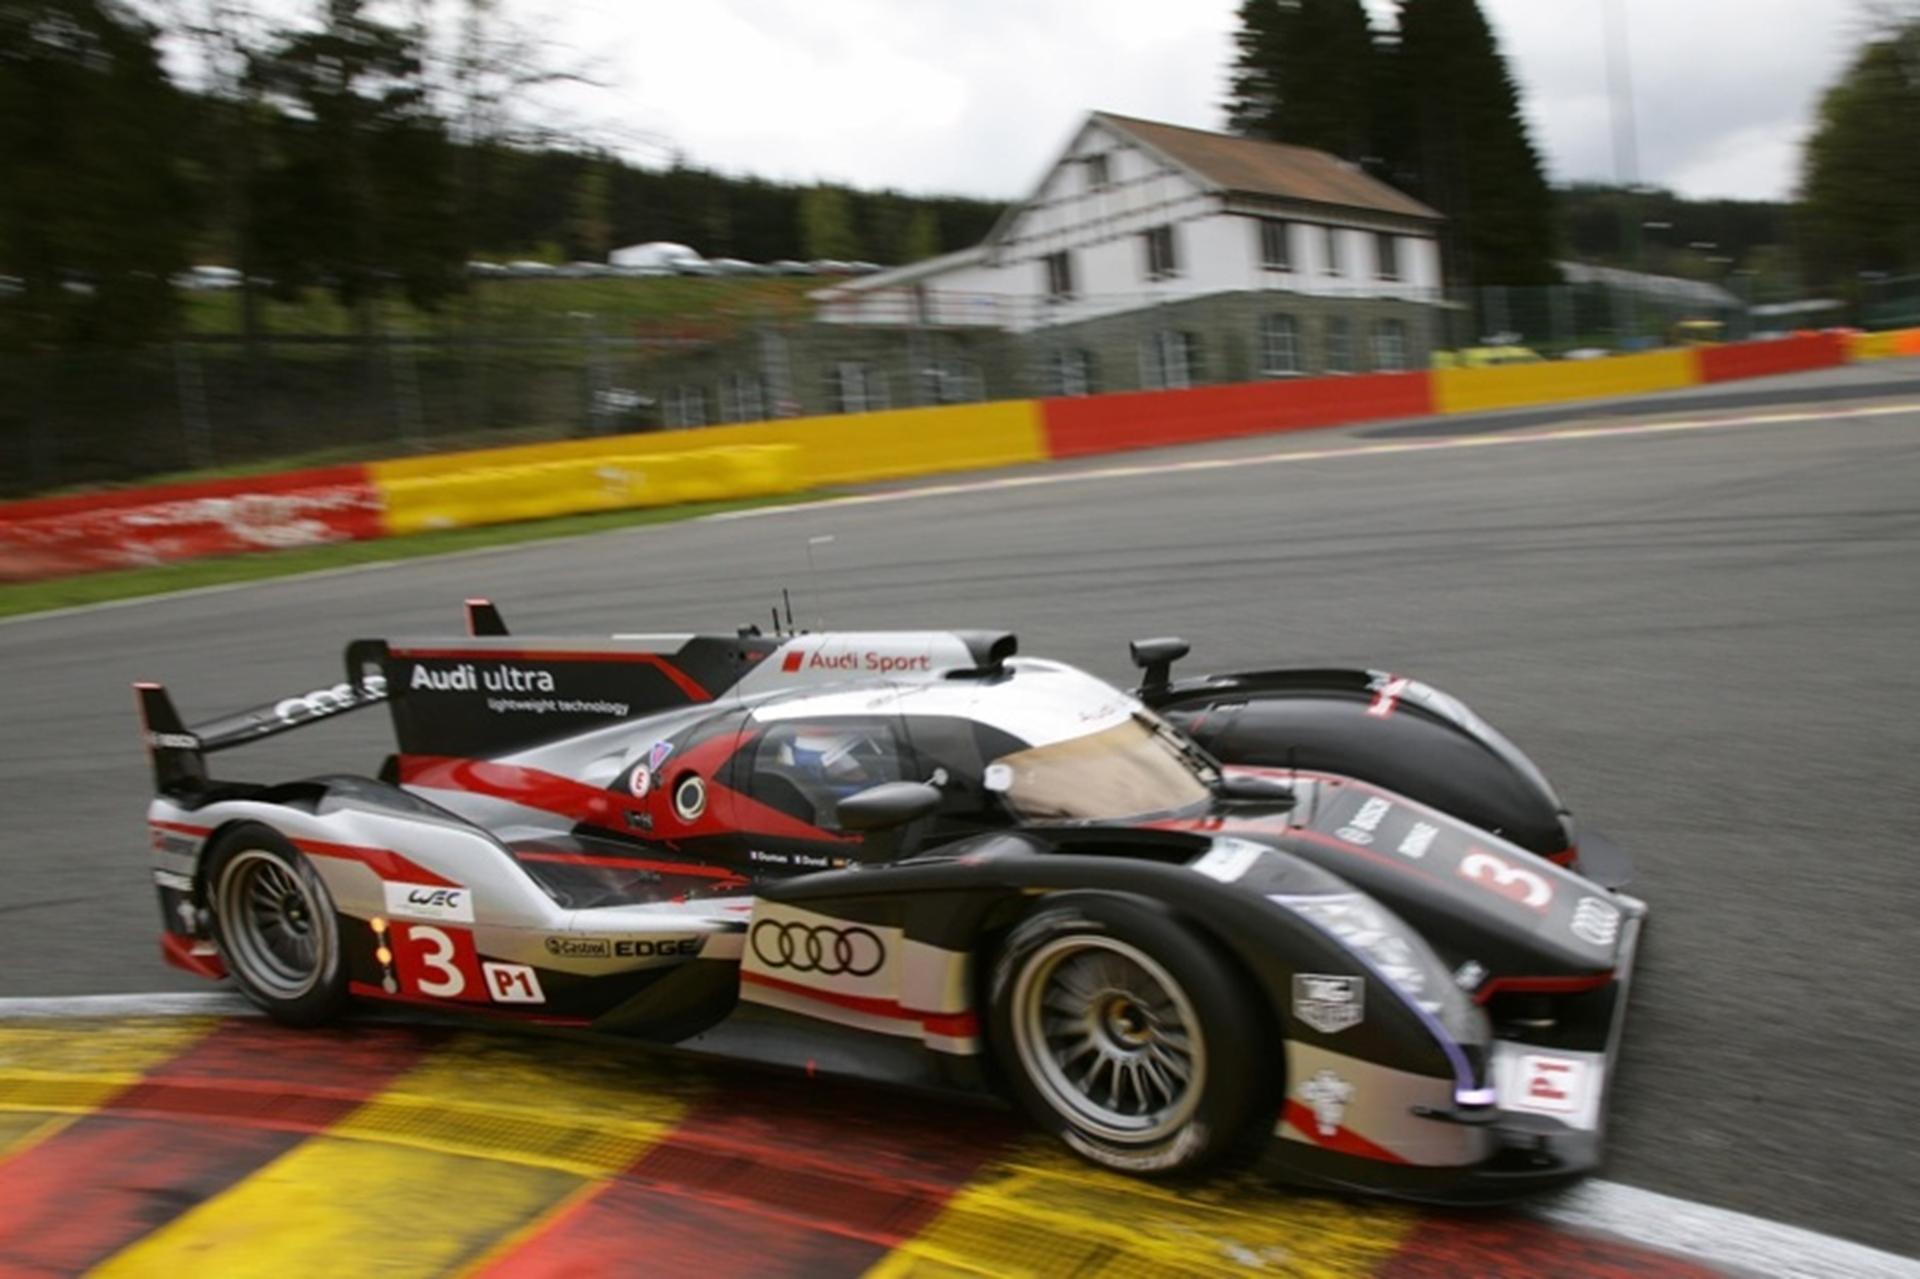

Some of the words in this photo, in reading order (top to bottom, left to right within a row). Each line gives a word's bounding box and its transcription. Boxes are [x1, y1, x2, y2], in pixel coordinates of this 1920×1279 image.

[809, 652, 858, 670] Audi
[865, 652, 931, 672] Sport
[410, 664, 478, 690] Audi
[483, 664, 555, 691] ultra
[487, 698, 557, 714] lightweight
[558, 700, 630, 716] technology
[1460, 853, 1552, 907] 3
[408, 889, 461, 908] WEC
[408, 925, 465, 997] 3
[614, 938, 698, 957] EDGE
[493, 969, 535, 998] P1
[1530, 1063, 1571, 1099] P1
